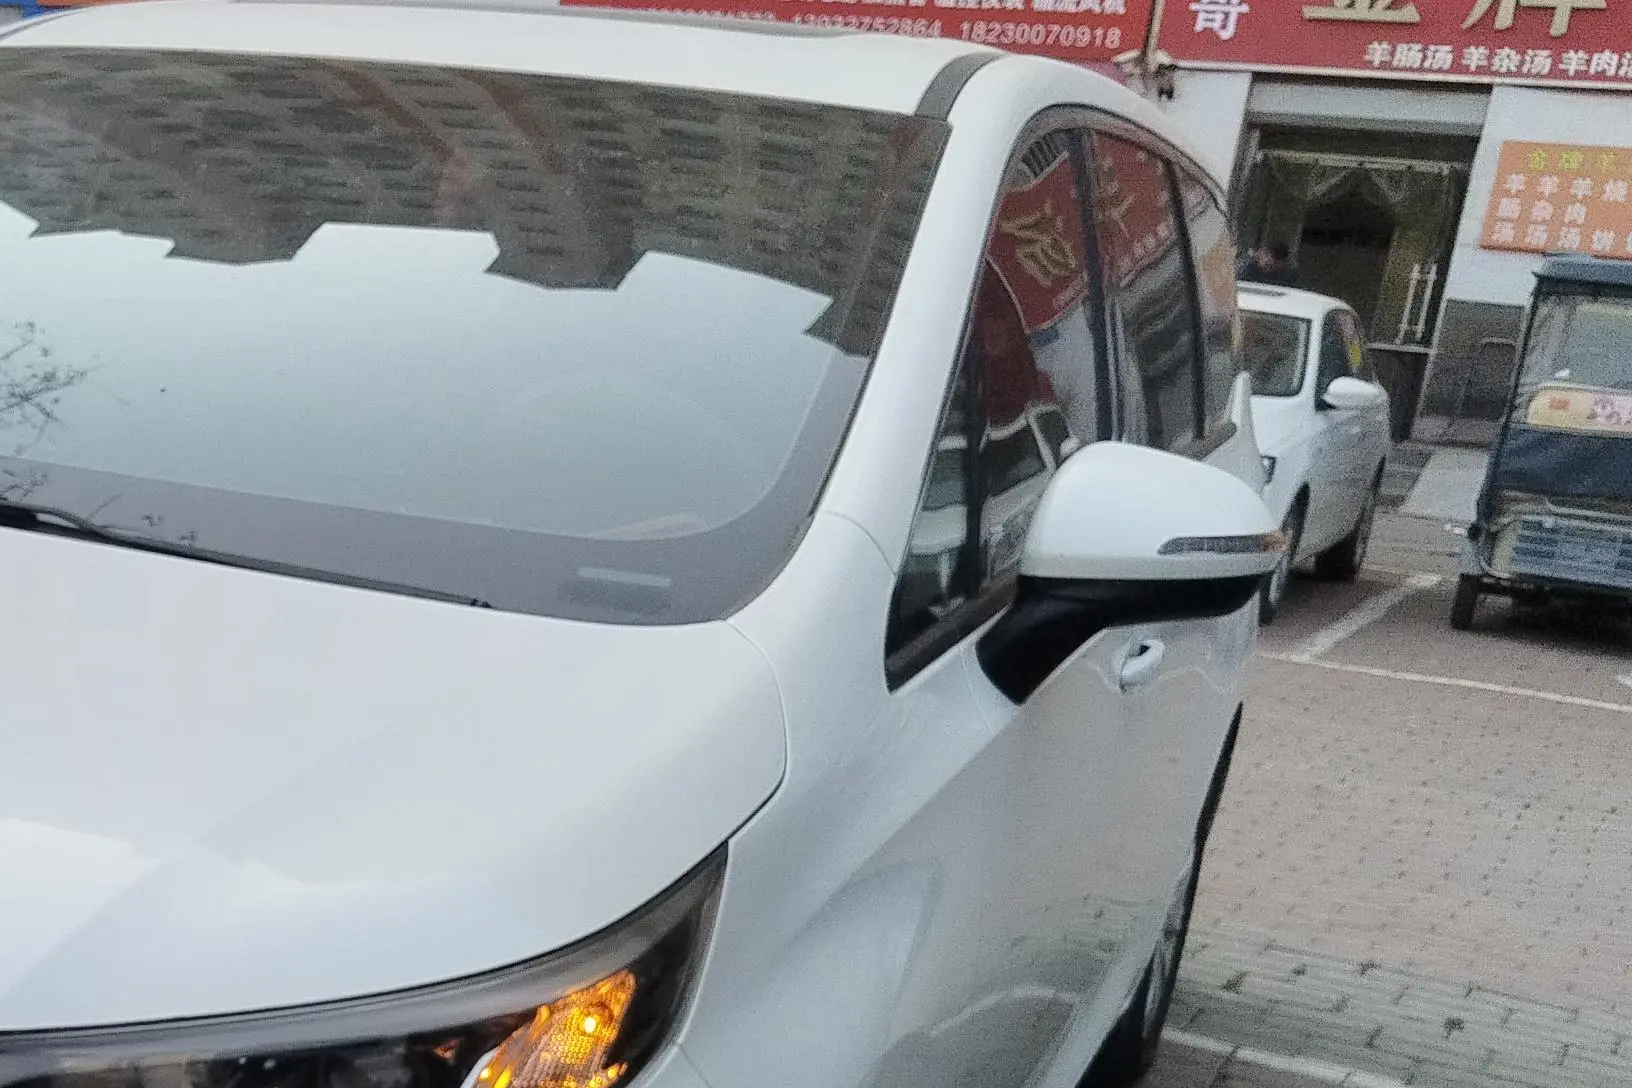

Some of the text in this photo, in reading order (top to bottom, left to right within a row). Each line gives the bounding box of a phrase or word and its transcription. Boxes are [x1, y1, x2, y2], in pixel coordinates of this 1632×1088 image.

[959, 20, 1121, 49] 18230070918
[1365, 41, 1453, 71] 羊肠汤
[1462, 45, 1552, 76] 羊杂汤
